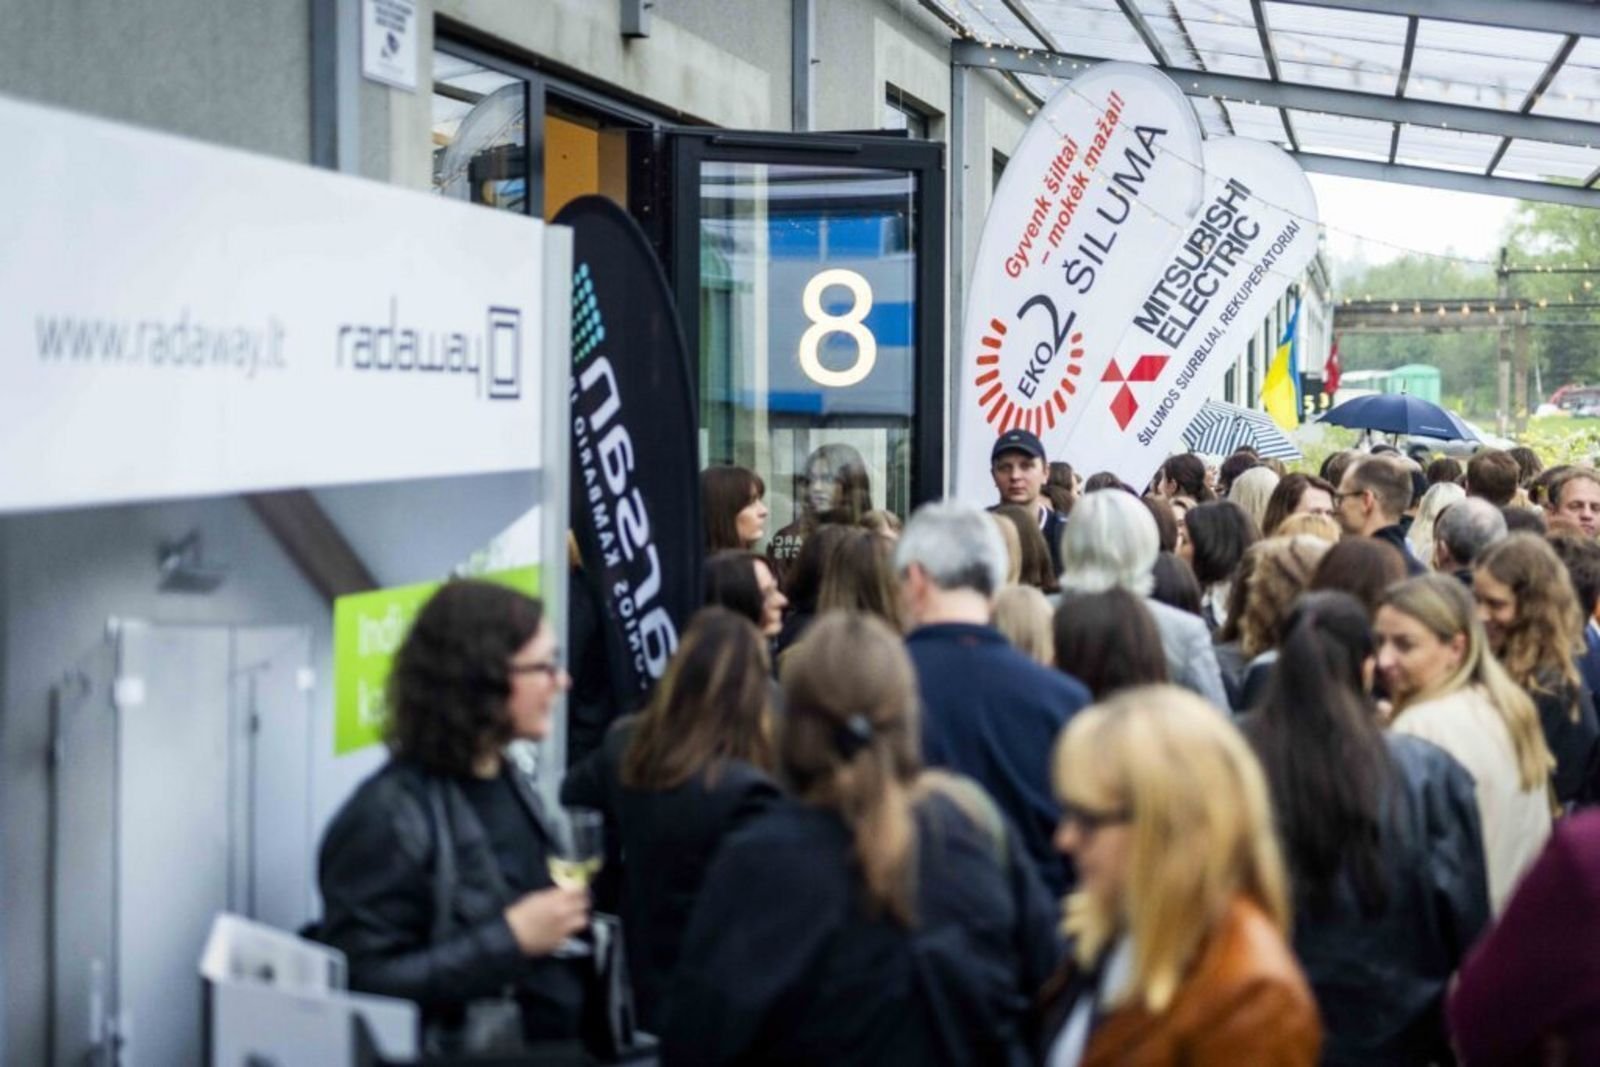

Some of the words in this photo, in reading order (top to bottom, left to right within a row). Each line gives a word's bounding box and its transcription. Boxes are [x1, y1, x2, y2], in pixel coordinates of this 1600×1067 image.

[1005, 192, 1053, 279] Gyvenk
[1045, 134, 1079, 196] šiltai
[1047, 170, 1091, 252] mokėk
[1083, 90, 1127, 172] mažai!
[1064, 123, 1168, 295] ŠILUMA
[799, 268, 877, 388] 8
[1132, 176, 1254, 335] MITSUBISHI
[1155, 214, 1261, 350] ELECTRIC
[35, 310, 289, 378] www.radaway.lt
[337, 297, 480, 398] radaway
[1137, 386, 1181, 448] ŠILUMOS
[1176, 323, 1225, 392] SIURBLIAI,
[1219, 218, 1301, 328] REKUPERATORIAI
